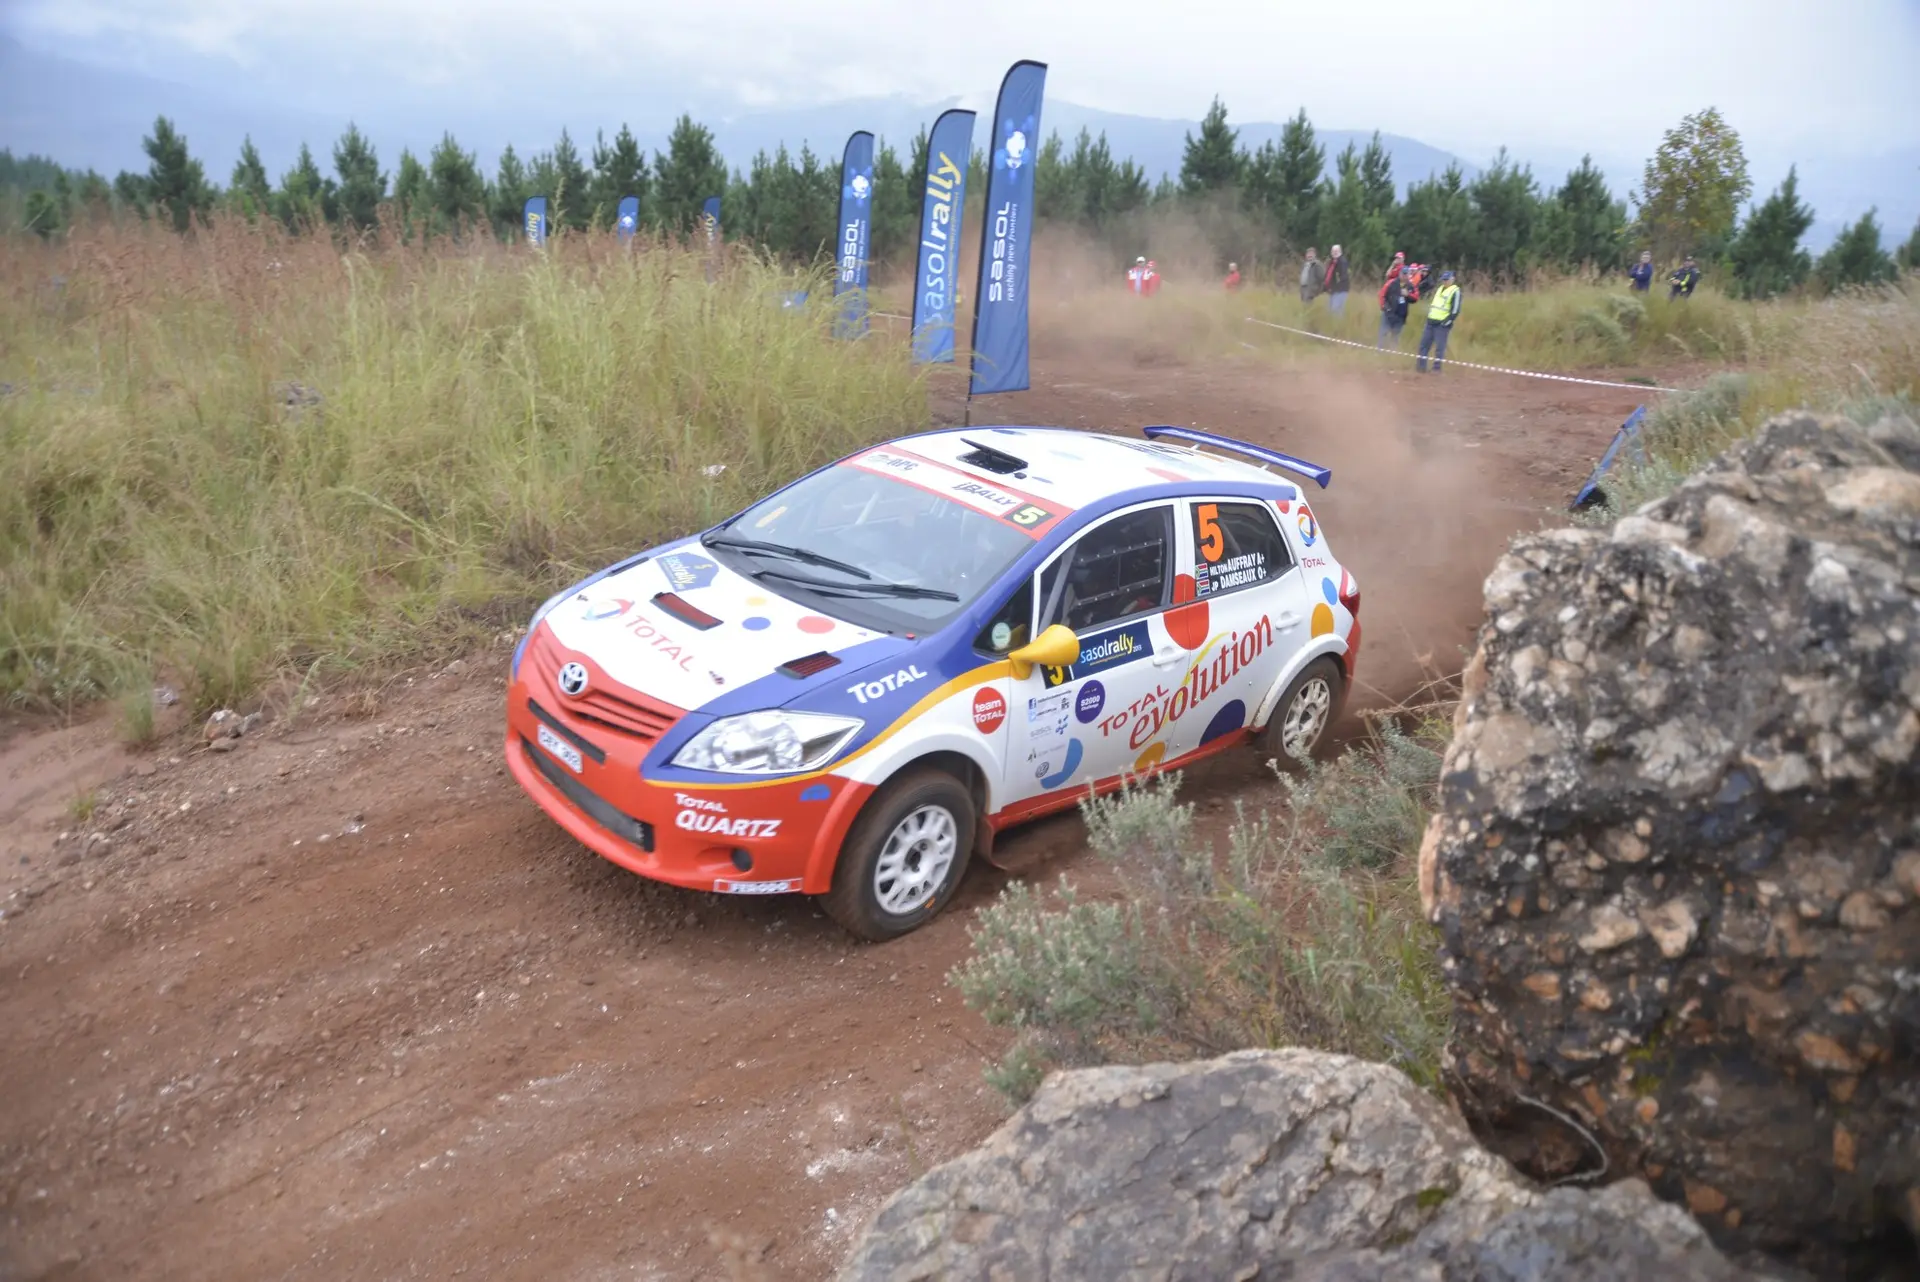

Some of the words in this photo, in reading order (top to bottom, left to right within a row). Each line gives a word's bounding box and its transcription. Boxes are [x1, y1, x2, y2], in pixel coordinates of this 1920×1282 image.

[1008, 203, 1018, 242] frontiers
[1005, 264, 1017, 302] reaching
[1012, 506, 1048, 524] 5
[1198, 504, 1224, 562] 5
[1227, 553, 1256, 572] AUFFRAY
[1256, 552, 1265, 565] A+
[1301, 558, 1326, 568] TOTAL
[1212, 581, 1218, 592] JP
[1220, 568, 1257, 589] DAMSEAUX
[626, 615, 694, 672] TOTAL
[1080, 633, 1134, 664] sasolrally
[846, 664, 928, 704] TOTAL
[1130, 614, 1273, 750] evolution
[975, 699, 1001, 713] team
[1080, 695, 1100, 706] S2000
[1098, 684, 1169, 736] TOTAL
[973, 710, 1005, 724] TOTAL
[674, 792, 728, 812] TOTAL
[675, 810, 782, 837] QUARTZ
